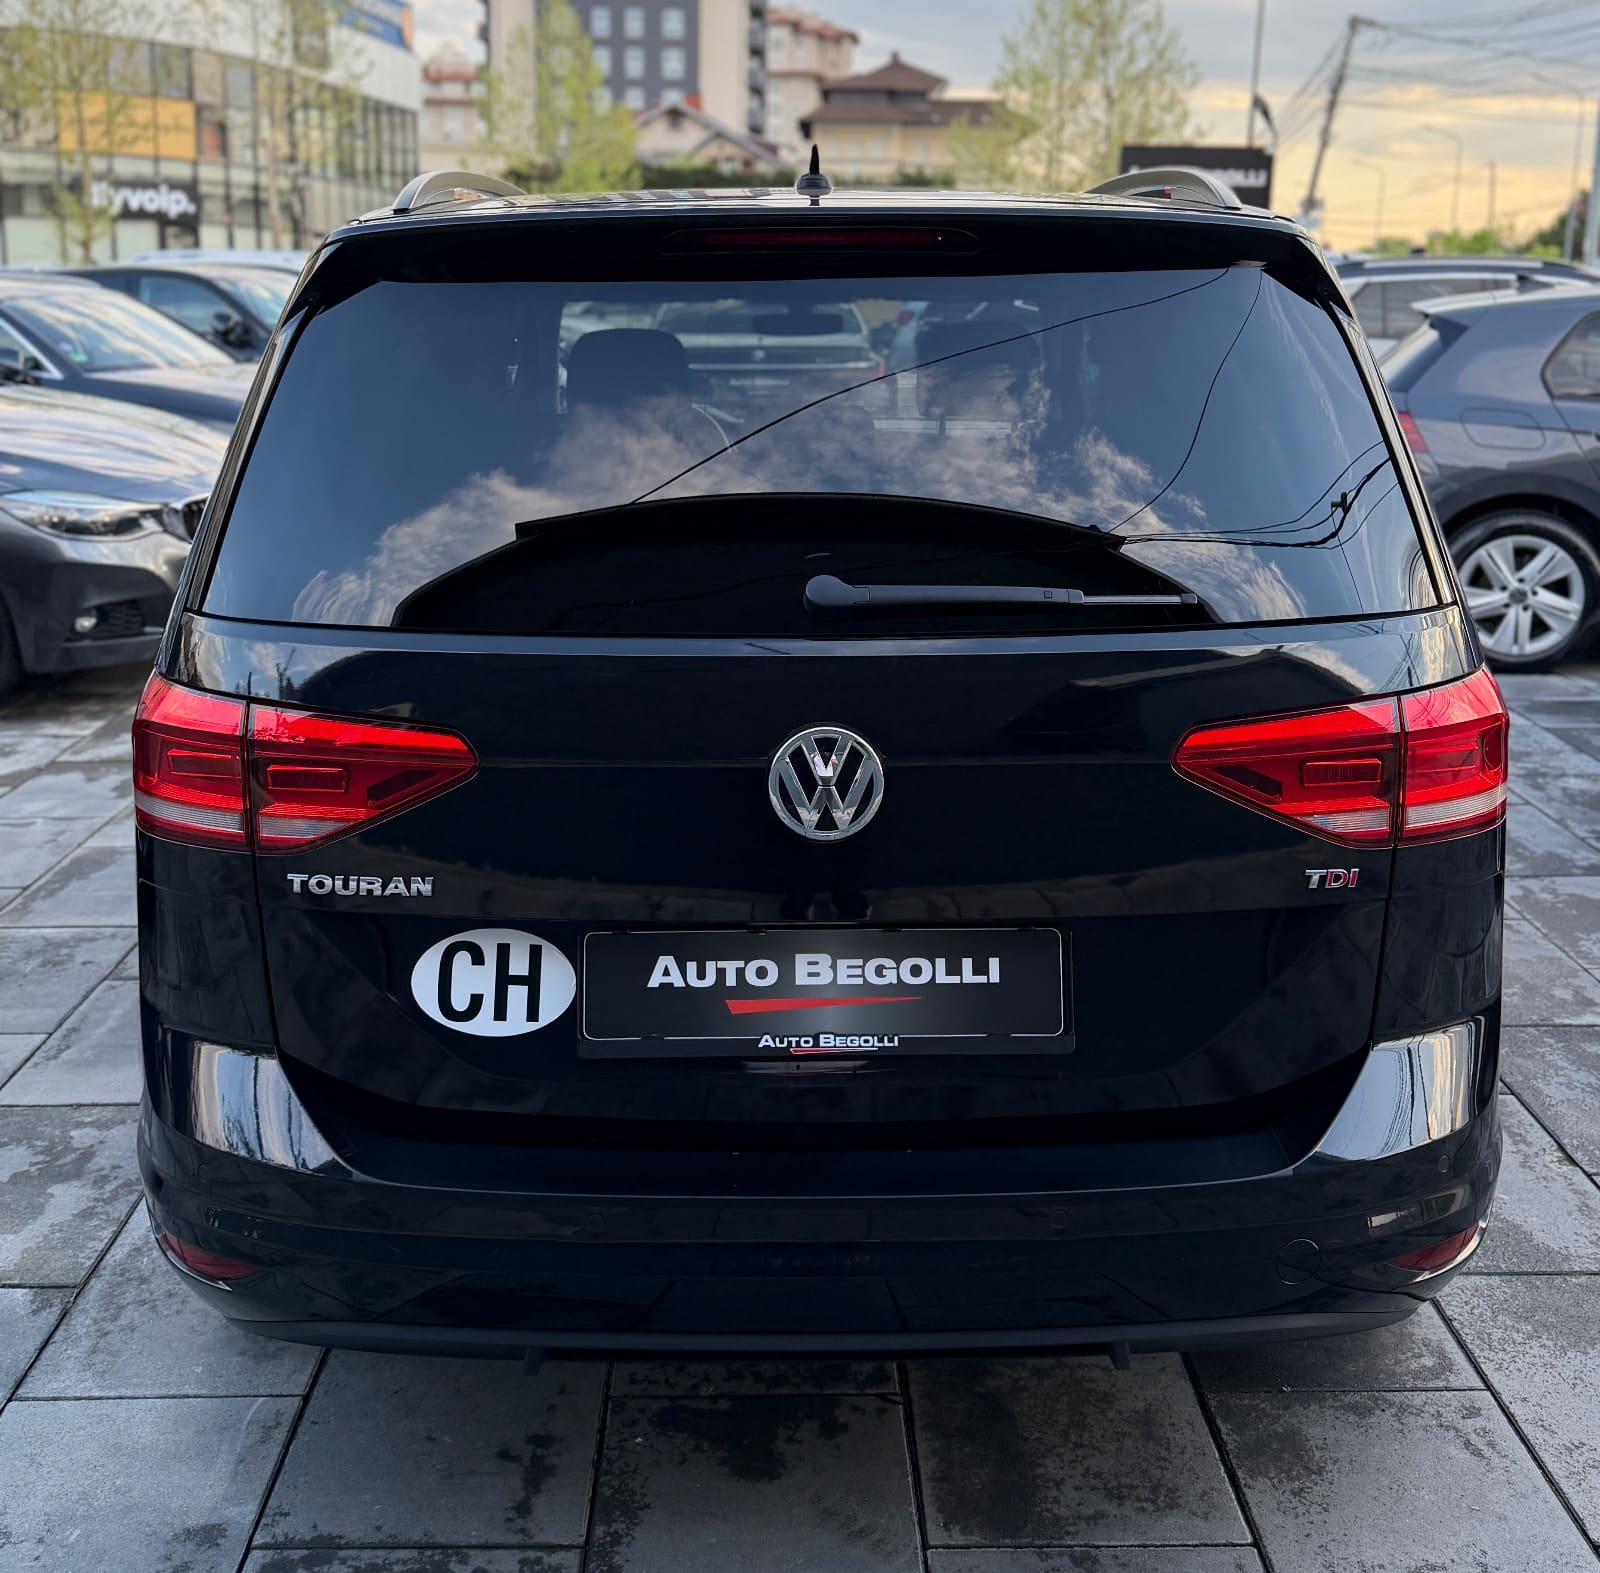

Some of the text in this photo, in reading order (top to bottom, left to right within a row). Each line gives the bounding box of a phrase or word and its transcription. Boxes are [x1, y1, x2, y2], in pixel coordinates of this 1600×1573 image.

[287, 873, 434, 897] TOURAN
[1305, 868, 1360, 888] TDI
[437, 940, 543, 1023] CH
[647, 953, 1000, 988] AUTO BEGOLLI
[758, 1033, 899, 1048] AUTO BEGOLLI
